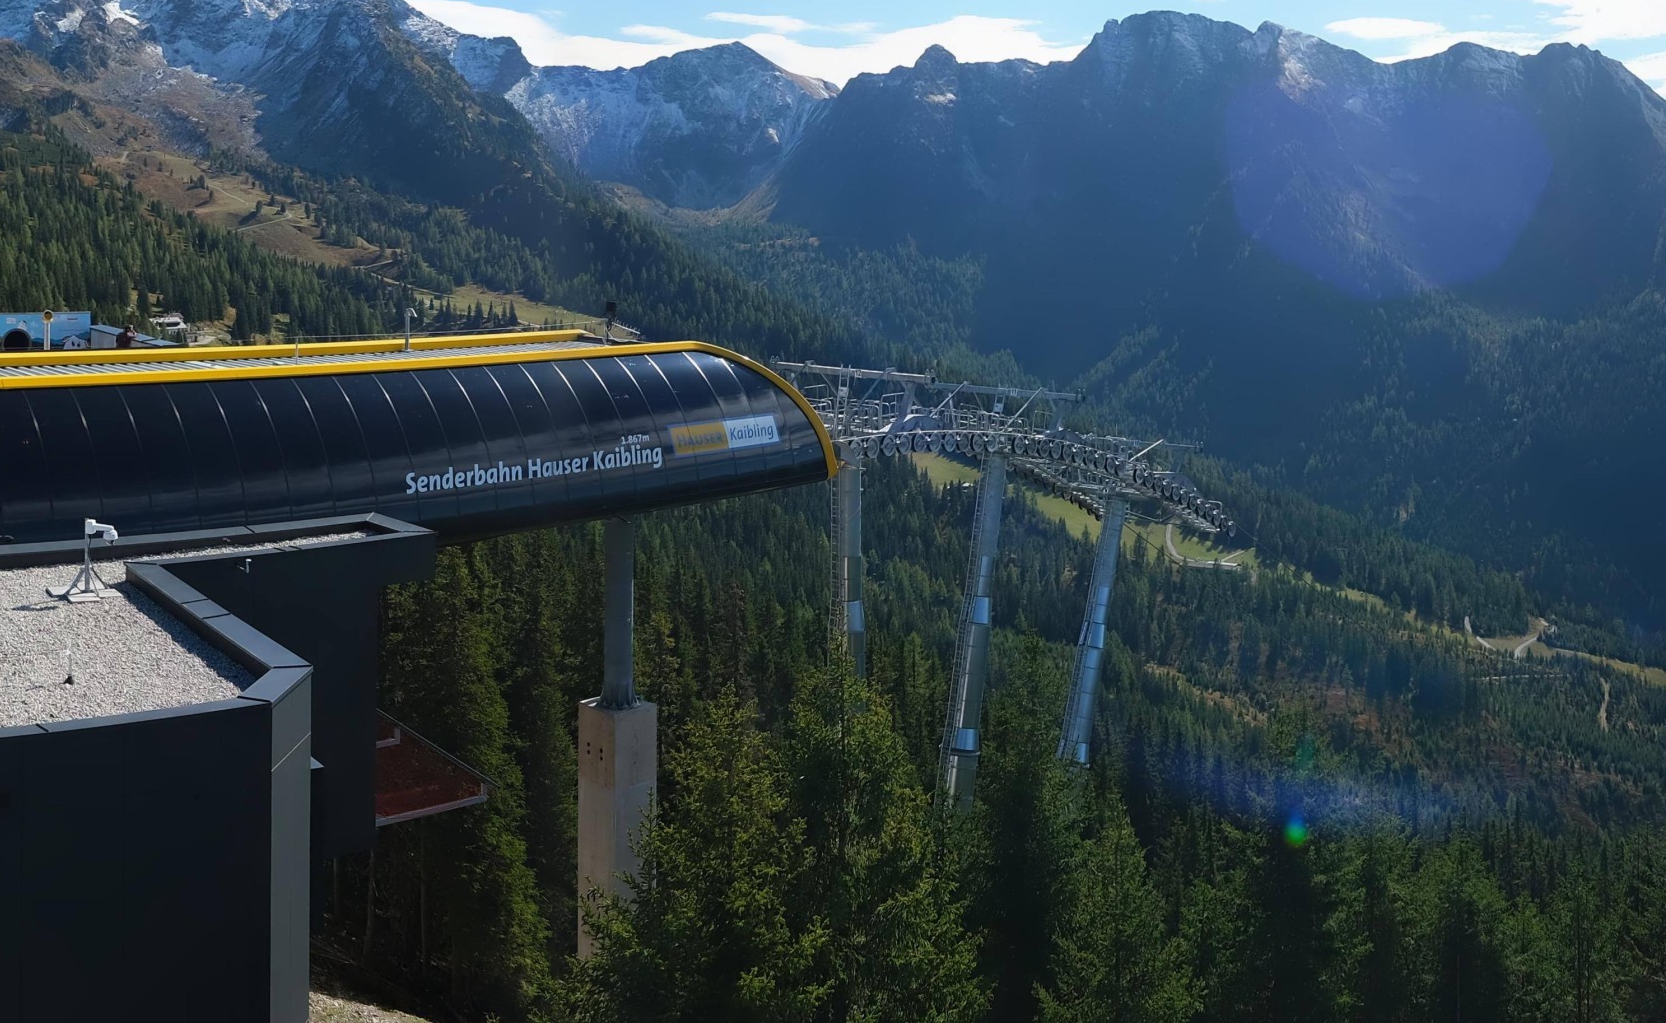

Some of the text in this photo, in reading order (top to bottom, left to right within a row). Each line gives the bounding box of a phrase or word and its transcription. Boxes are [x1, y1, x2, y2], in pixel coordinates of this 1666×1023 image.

[620, 433, 650, 446] 1.867m
[676, 424, 774, 449] HAUSER Kaibling
[405, 444, 663, 495] Senderbahn Hauser Kaibling
